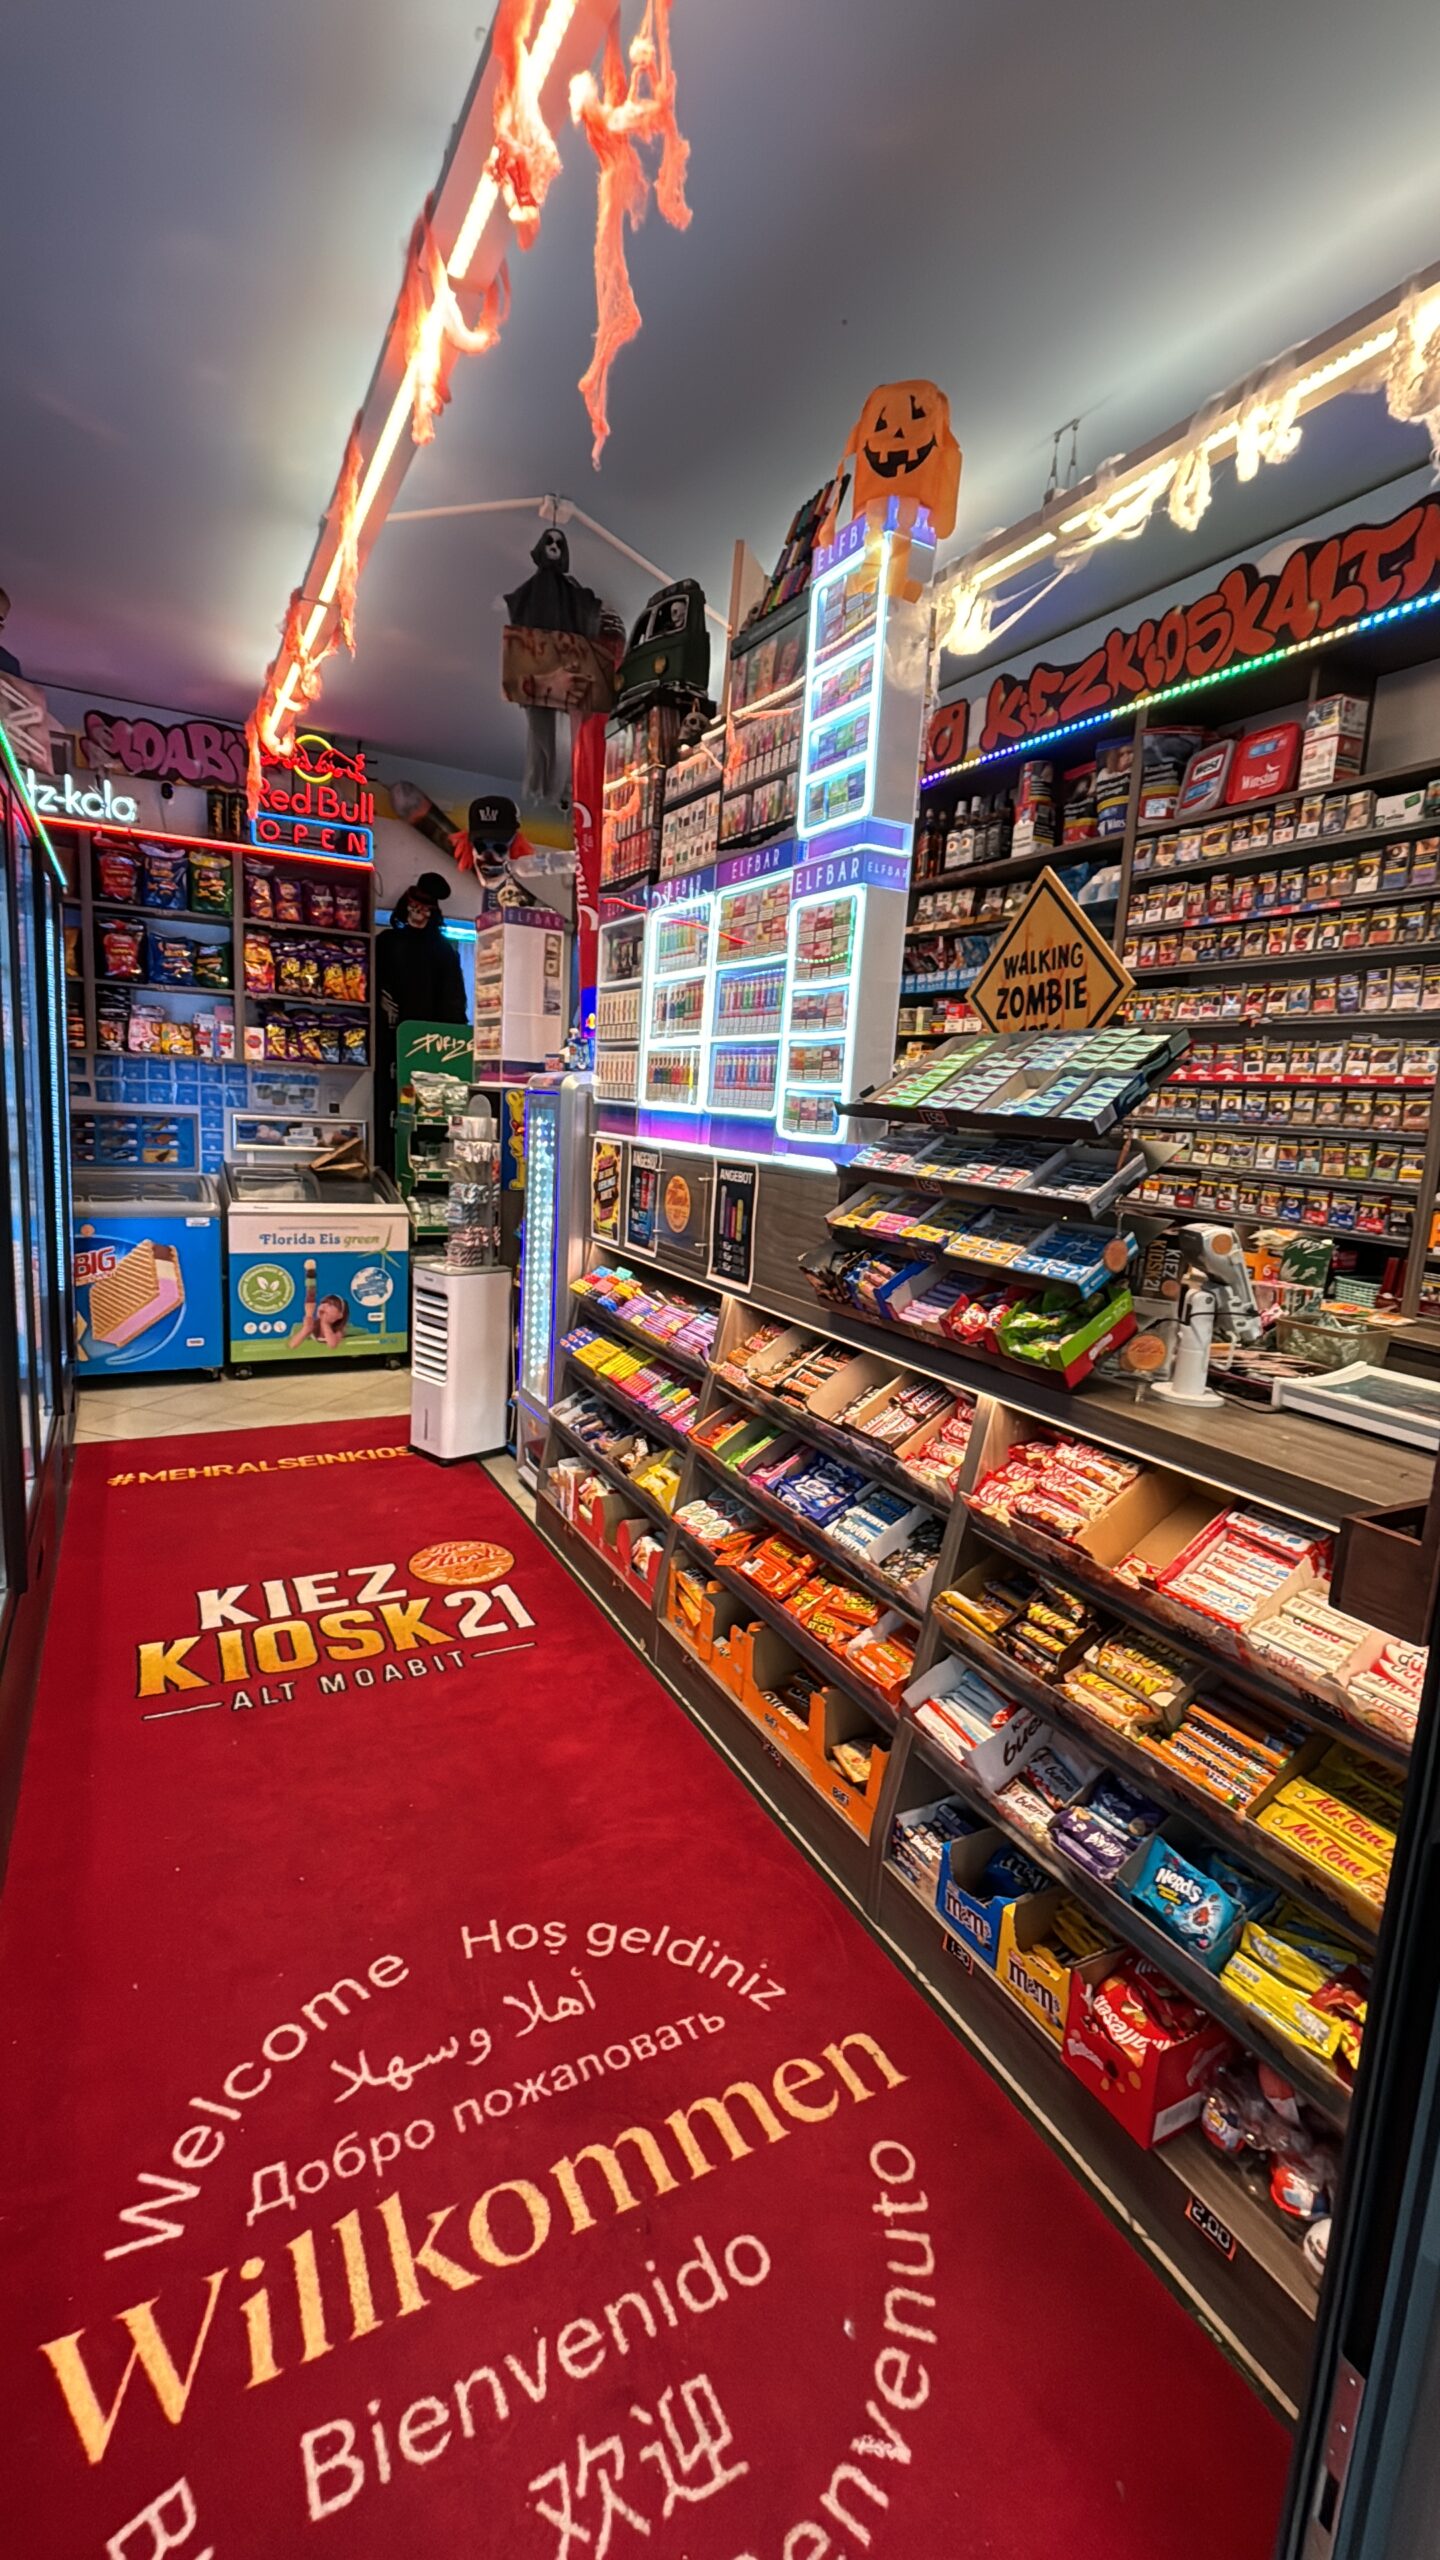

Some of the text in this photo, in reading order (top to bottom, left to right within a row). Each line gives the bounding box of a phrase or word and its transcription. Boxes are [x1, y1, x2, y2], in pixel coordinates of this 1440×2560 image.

[317, 786, 375, 824] Bull
[258, 819, 367, 854] OPEN
[731, 848, 780, 879] ELFBAR
[796, 857, 860, 894] ELFBAR
[867, 861, 908, 879] ELFBAR
[1003, 942, 1084, 979] WALKING
[996, 974, 1087, 1019] ZOMBIE
[719, 1168, 753, 1185] ANGEBOT
[259, 1232, 380, 1247] Florida Eis green
[74, 1245, 116, 1279] BIG
[1143, 1240, 1168, 1291] KIOSK 21
[1162, 1249, 1182, 1279] KIEZ
[106, 1445, 414, 1487] #MEHRALSEINKIOS
[196, 1562, 408, 1631] KIEZ
[136, 1583, 537, 1699] KIOSK 21
[232, 1650, 467, 1711] ALT MOABIT
[460, 1919, 788, 2012] Hoş geldiniz
[103, 1953, 410, 2261] Welcome
[246, 2117, 437, 2227] Добро
[38, 2031, 910, 2466] Willkommen
[300, 2233, 771, 2523] Bienvenido
[528, 2373, 750, 2560] 欢迎
